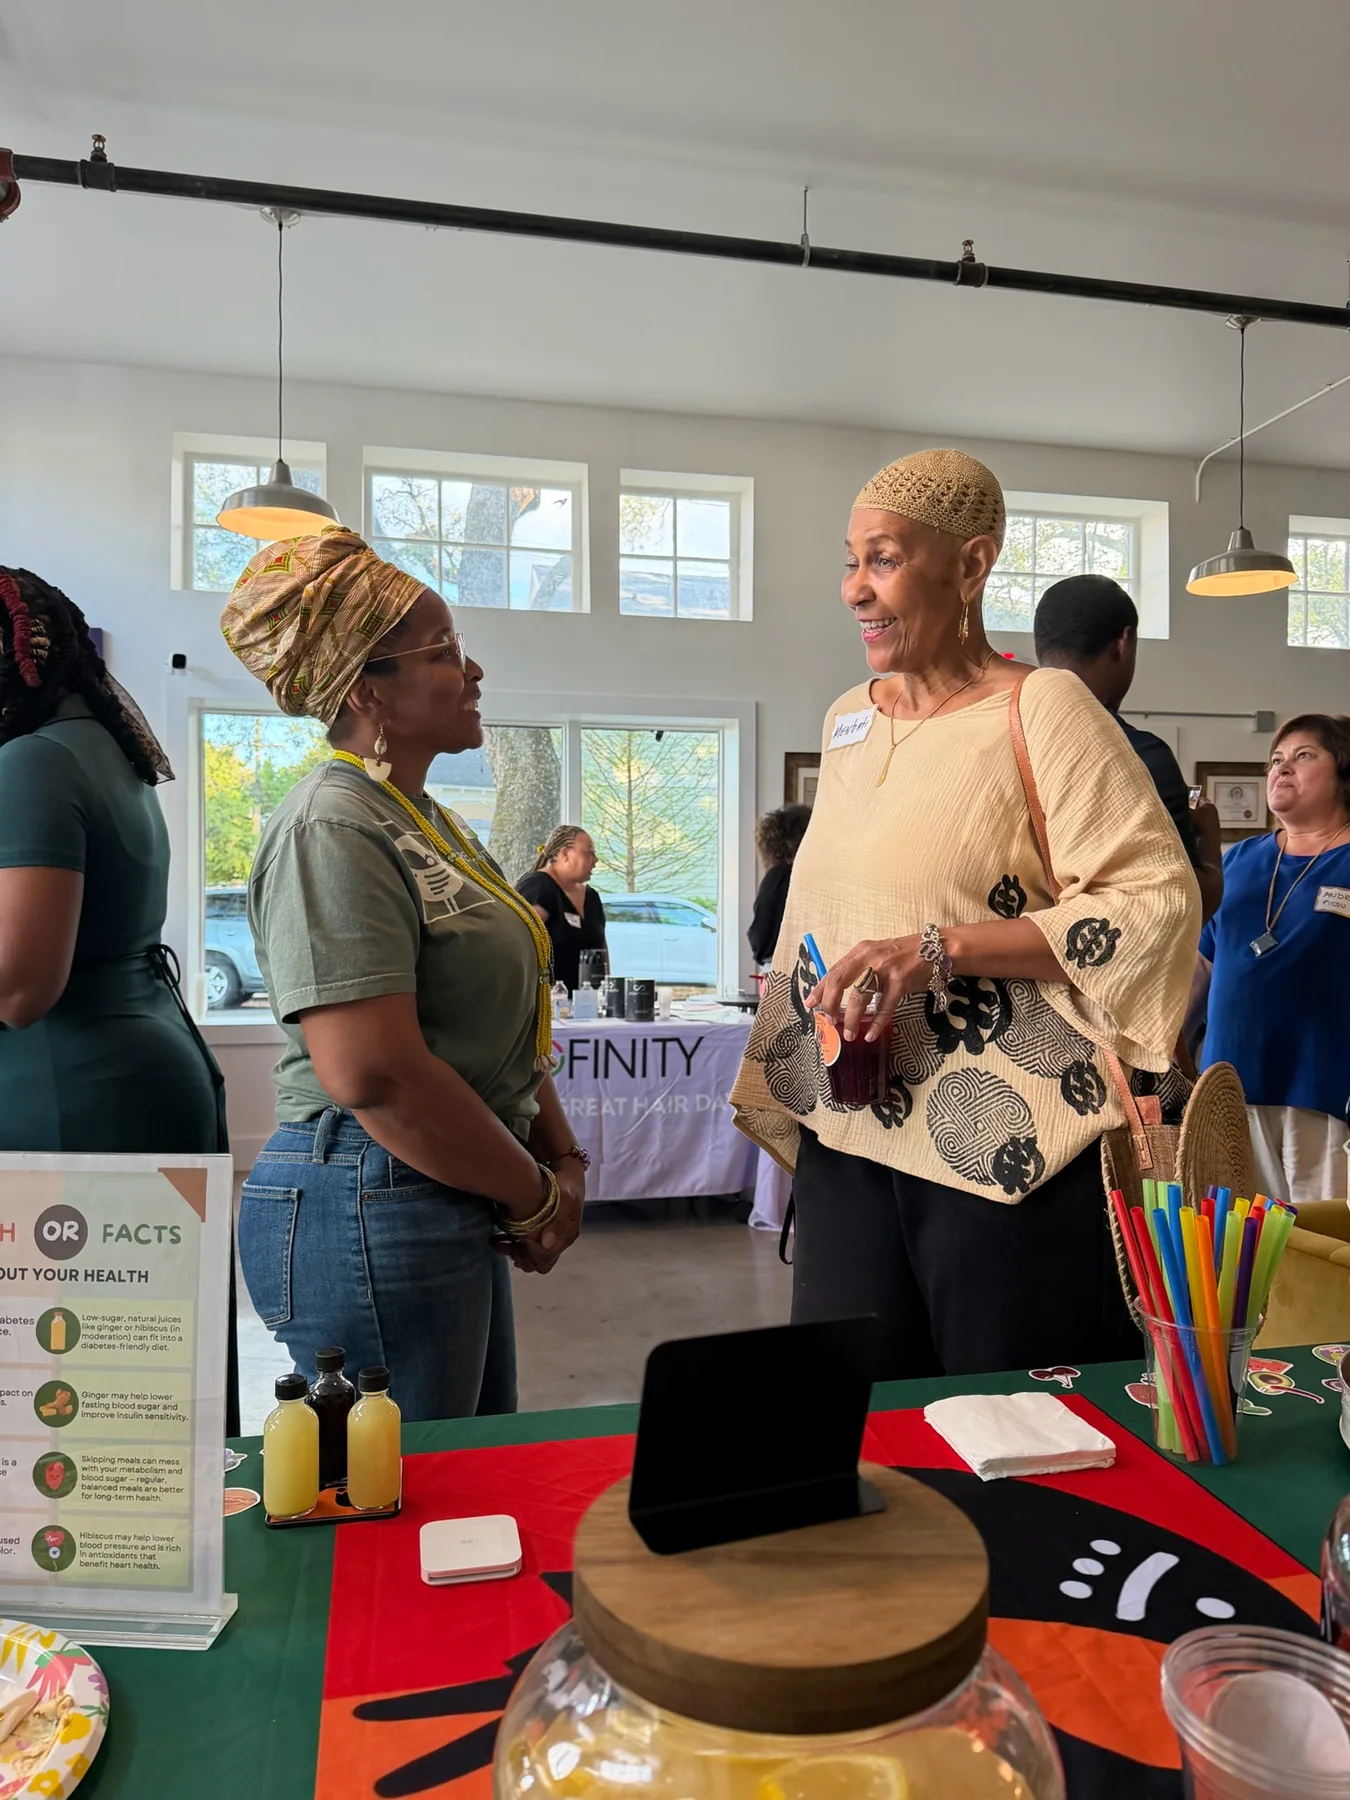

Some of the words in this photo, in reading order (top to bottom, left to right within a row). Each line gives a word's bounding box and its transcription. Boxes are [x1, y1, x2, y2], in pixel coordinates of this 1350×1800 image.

[632, 1096, 689, 1116] HAIR
[696, 1093, 730, 1112] DA
[42, 1220, 79, 1242] OR
[102, 1223, 182, 1245] FACTS
[32, 1268, 79, 1282] YOUR
[84, 1269, 149, 1283] HEALTH
[82, 1314, 126, 1323] Low-sugar,
[157, 1315, 182, 1323] juices
[97, 1324, 122, 1332] ginger
[135, 1324, 168, 1332] hibiscus
[170, 1325, 180, 1333] (in
[82, 1333, 131, 1342] moderation)
[160, 1334, 176, 1342] into
[81, 1342, 149, 1352] diabetes-friendly
[81, 1391, 109, 1400] Ginger
[111, 1393, 129, 1401] may
[130, 1392, 148, 1401] help
[81, 1401, 110, 1410] fasting
[137, 1403, 160, 1411] sugar
[162, 1403, 178, 1411] and
[81, 1411, 115, 1419] improve
[145, 1412, 189, 1422] sensitivity.
[81, 1456, 115, 1464] Skipping
[100, 1466, 118, 1474] your
[119, 1466, 166, 1474] metabolism
[105, 1475, 128, 1483] sugar
[136, 1476, 167, 1484] regular,
[81, 1483, 118, 1491] balanced
[81, 1492, 93, 1500] for
[94, 1493, 134, 1501] long-term
[135, 1494, 163, 1502] health.
[80, 1532, 113, 1540] Hibiscus
[115, 1534, 132, 1542] may
[133, 1533, 151, 1542] help
[80, 1541, 102, 1549] blood
[165, 1544, 181, 1552] rich
[88, 1551, 138, 1559] antioxidants
[80, 1560, 108, 1568] benefit
[109, 1561, 131, 1569] heart
[133, 1561, 160, 1570] health.
